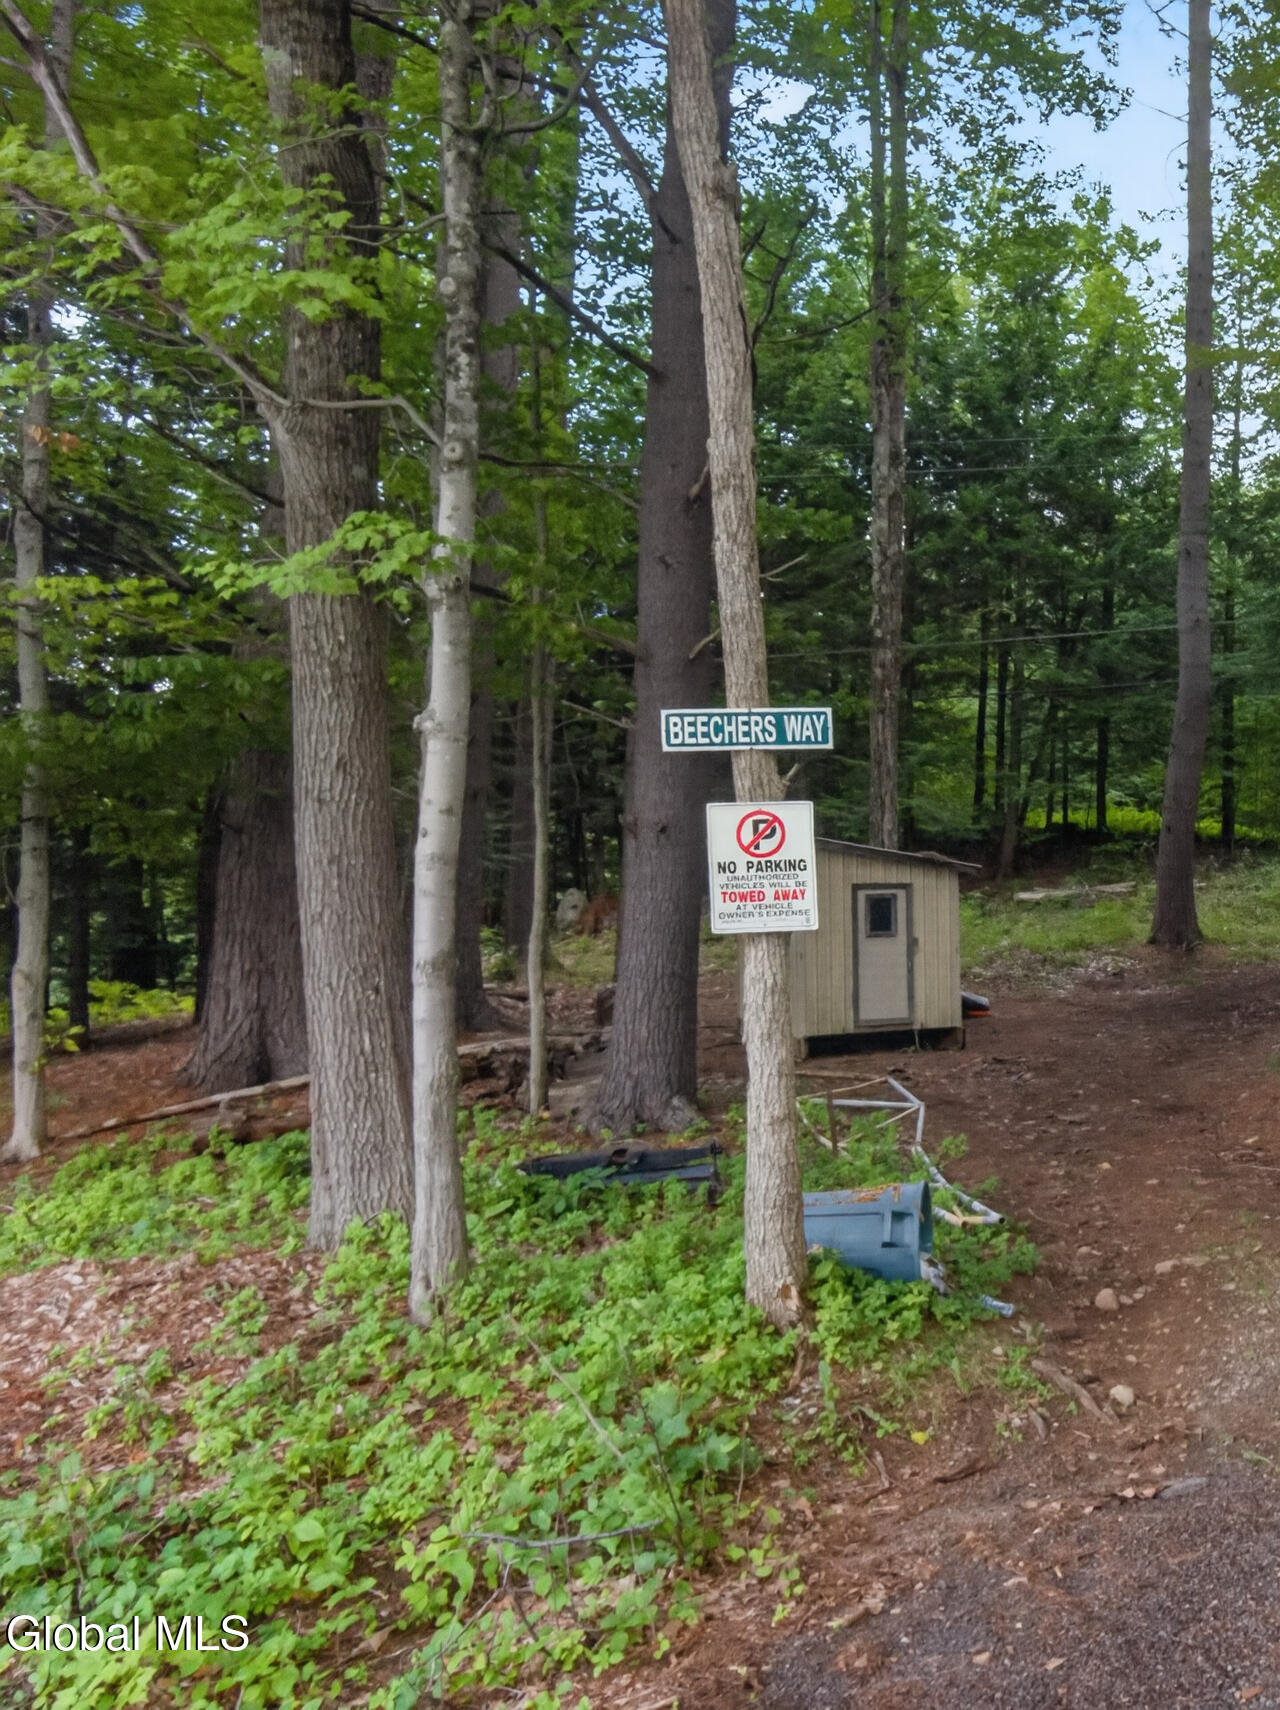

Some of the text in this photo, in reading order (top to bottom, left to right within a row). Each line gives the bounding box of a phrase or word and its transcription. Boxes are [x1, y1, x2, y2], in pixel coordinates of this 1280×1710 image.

[669, 714, 826, 744] BEECHERS WAY
[717, 859, 808, 874] NO PARKING
[726, 873, 799, 882] UNAUTHORIZED
[720, 880, 808, 890] VEHICLES WILL BE
[721, 889, 807, 903] TOWED AWAY
[753, 902, 793, 910] VEHICLE
[718, 908, 811, 920] OWNER'S EXPENSE
